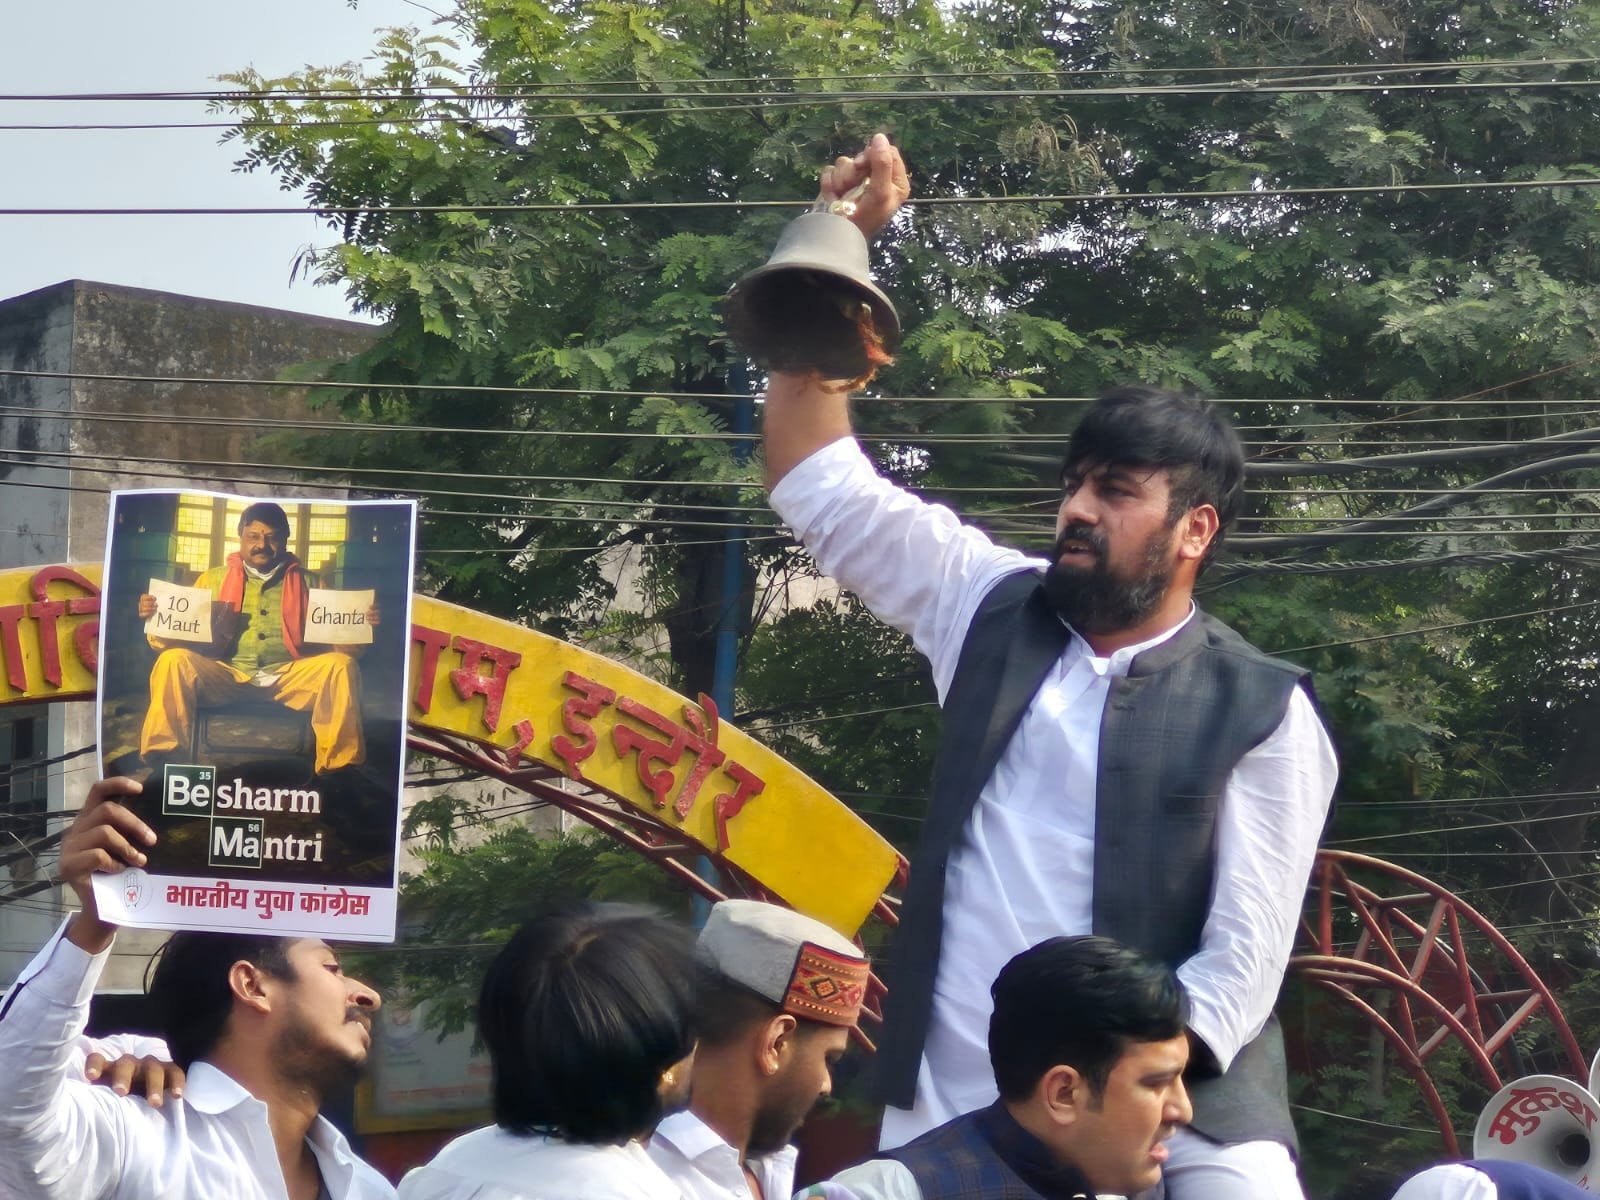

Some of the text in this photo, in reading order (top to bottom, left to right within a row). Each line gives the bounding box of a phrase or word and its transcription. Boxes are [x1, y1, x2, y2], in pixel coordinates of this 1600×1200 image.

[167, 595, 190, 613] 10
[311, 606, 366, 625] Ghanta
[157, 611, 201, 634] Maut
[551, 670, 767, 851] इन्दौर
[199, 771, 212, 781] 35
[213, 826, 323, 863] Mantri
[166, 881, 371, 920] भारतीय युवा कांग्रेस
